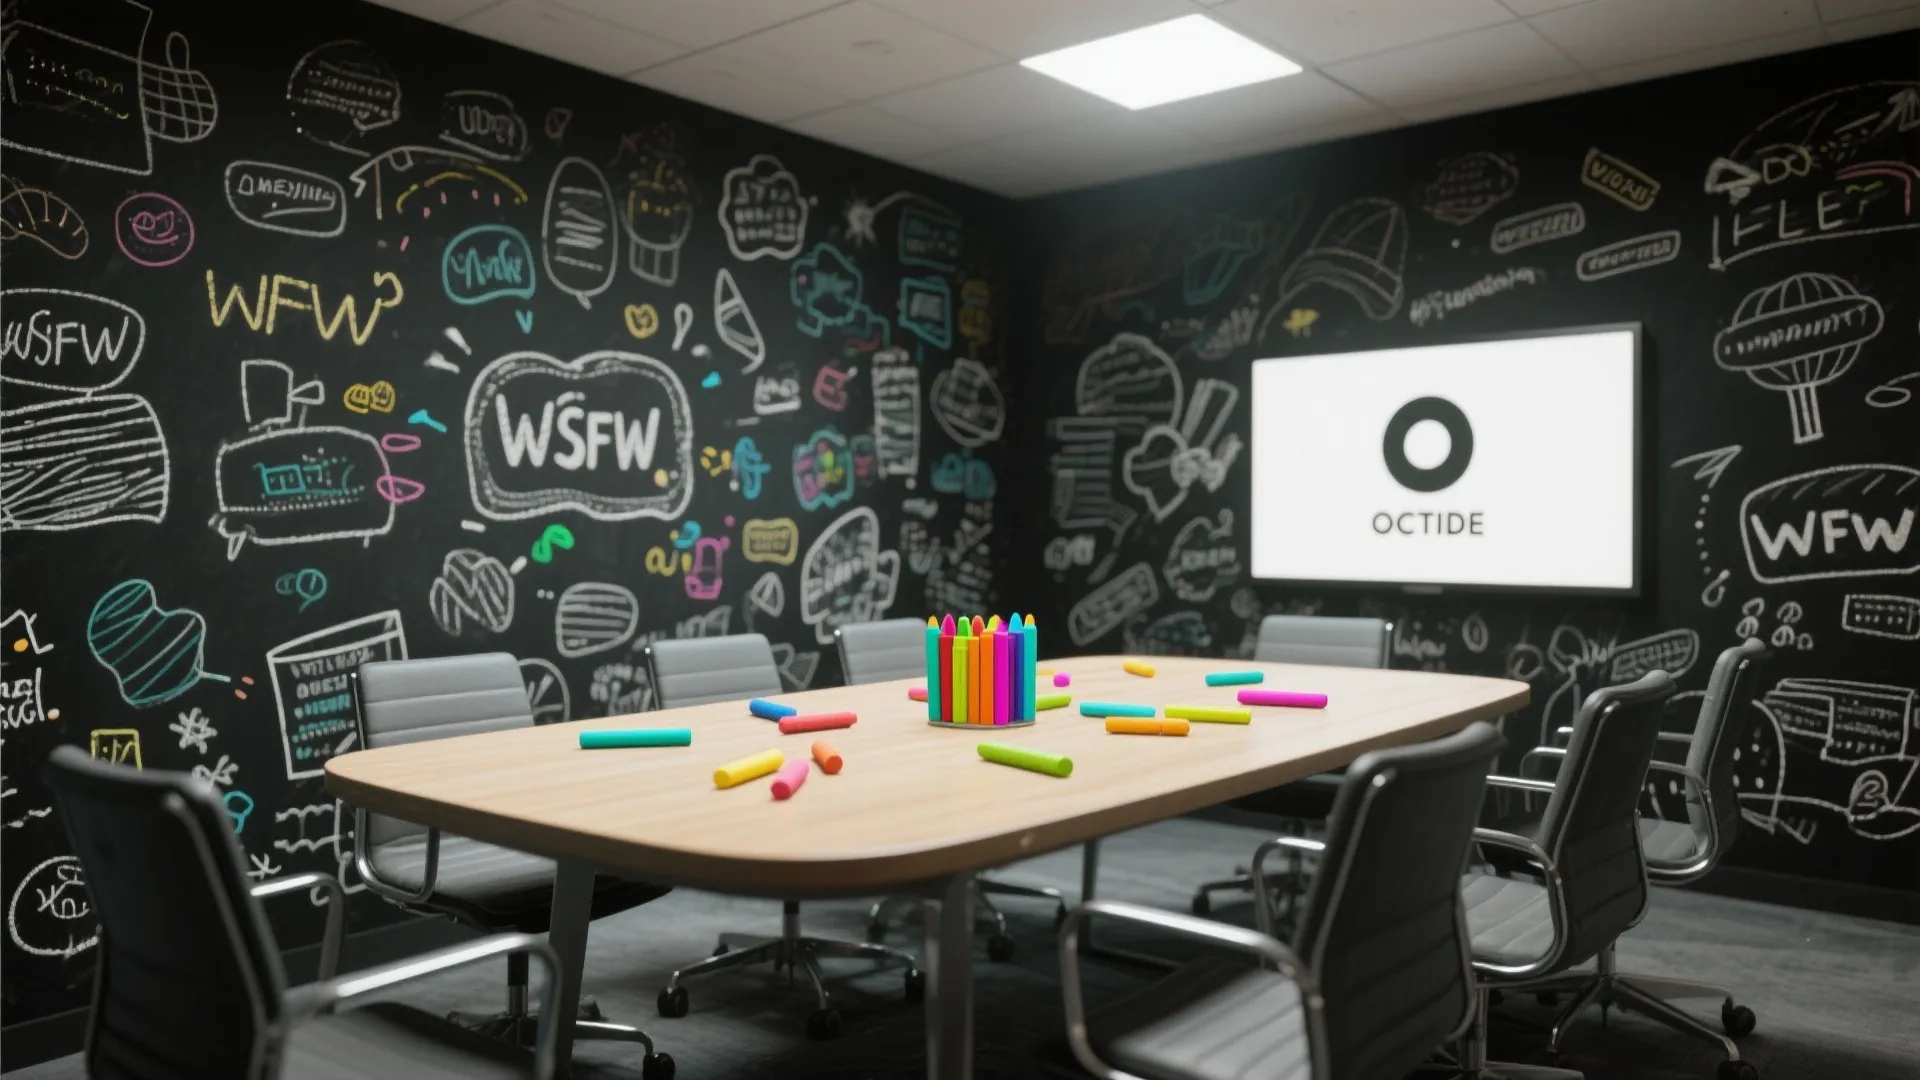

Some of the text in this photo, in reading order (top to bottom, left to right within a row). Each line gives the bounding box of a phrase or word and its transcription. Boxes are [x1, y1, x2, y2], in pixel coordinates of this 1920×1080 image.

[495, 391, 662, 472] WSFW
[1372, 511, 1485, 536] OCTIDE
[1751, 508, 1914, 562] WFW
